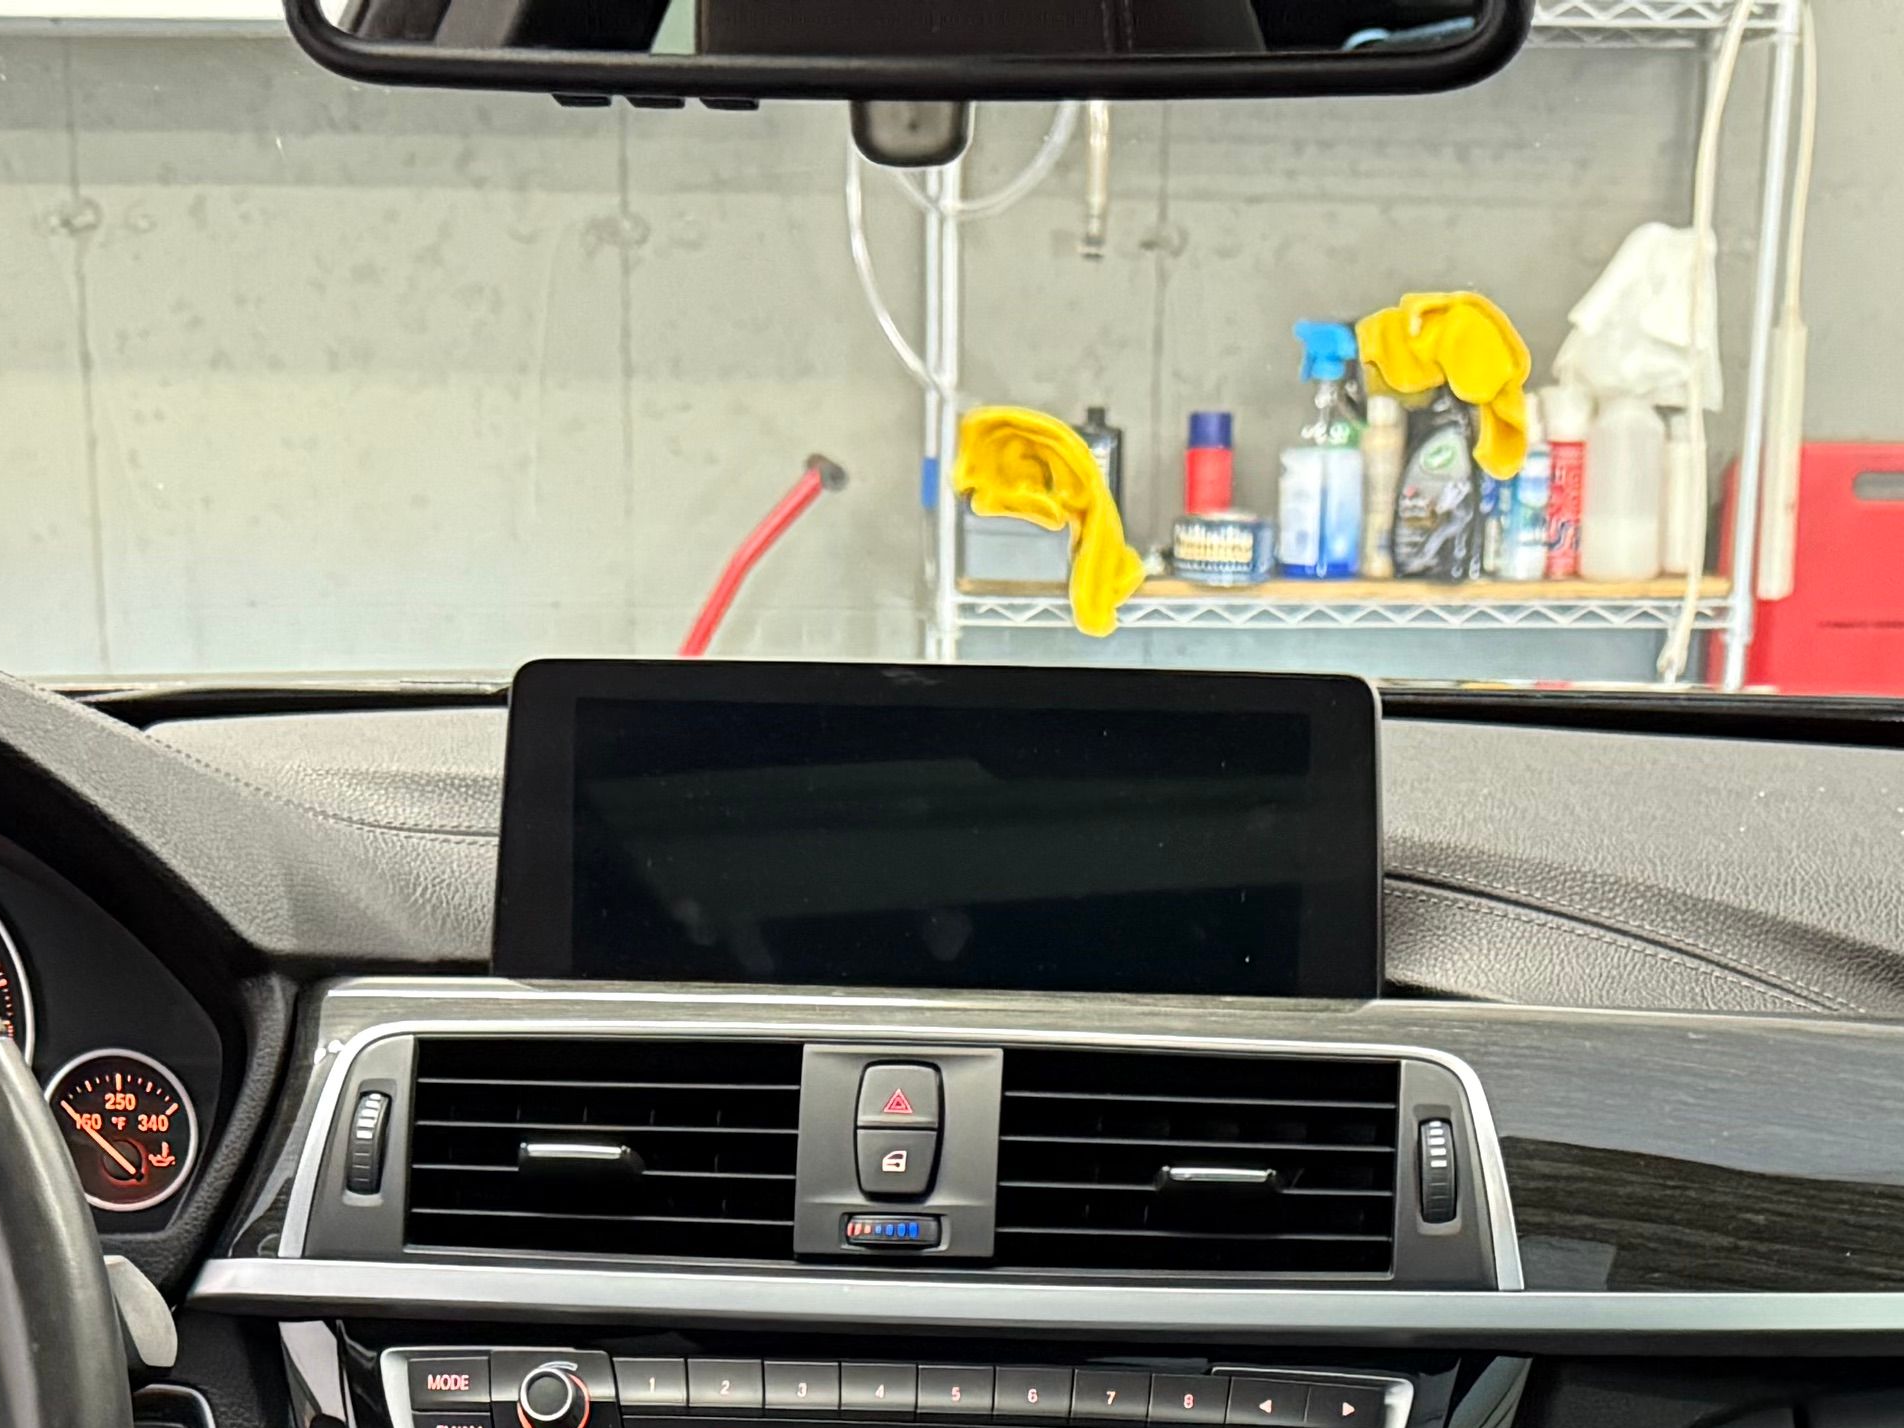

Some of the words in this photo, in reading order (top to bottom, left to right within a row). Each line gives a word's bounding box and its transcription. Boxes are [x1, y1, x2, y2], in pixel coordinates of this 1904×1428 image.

[104, 1093, 136, 1111] 250
[137, 1114, 169, 1132] 340
[427, 1374, 469, 1391] MODE
[648, 1377, 656, 1392] 1
[720, 1380, 730, 1395] 2
[797, 1383, 807, 1398] 3
[875, 1383, 885, 1399] 4
[951, 1387, 961, 1403] 5
[1027, 1388, 1037, 1404] 6
[1106, 1390, 1116, 1405] 7
[1183, 1393, 1194, 1409] 8
